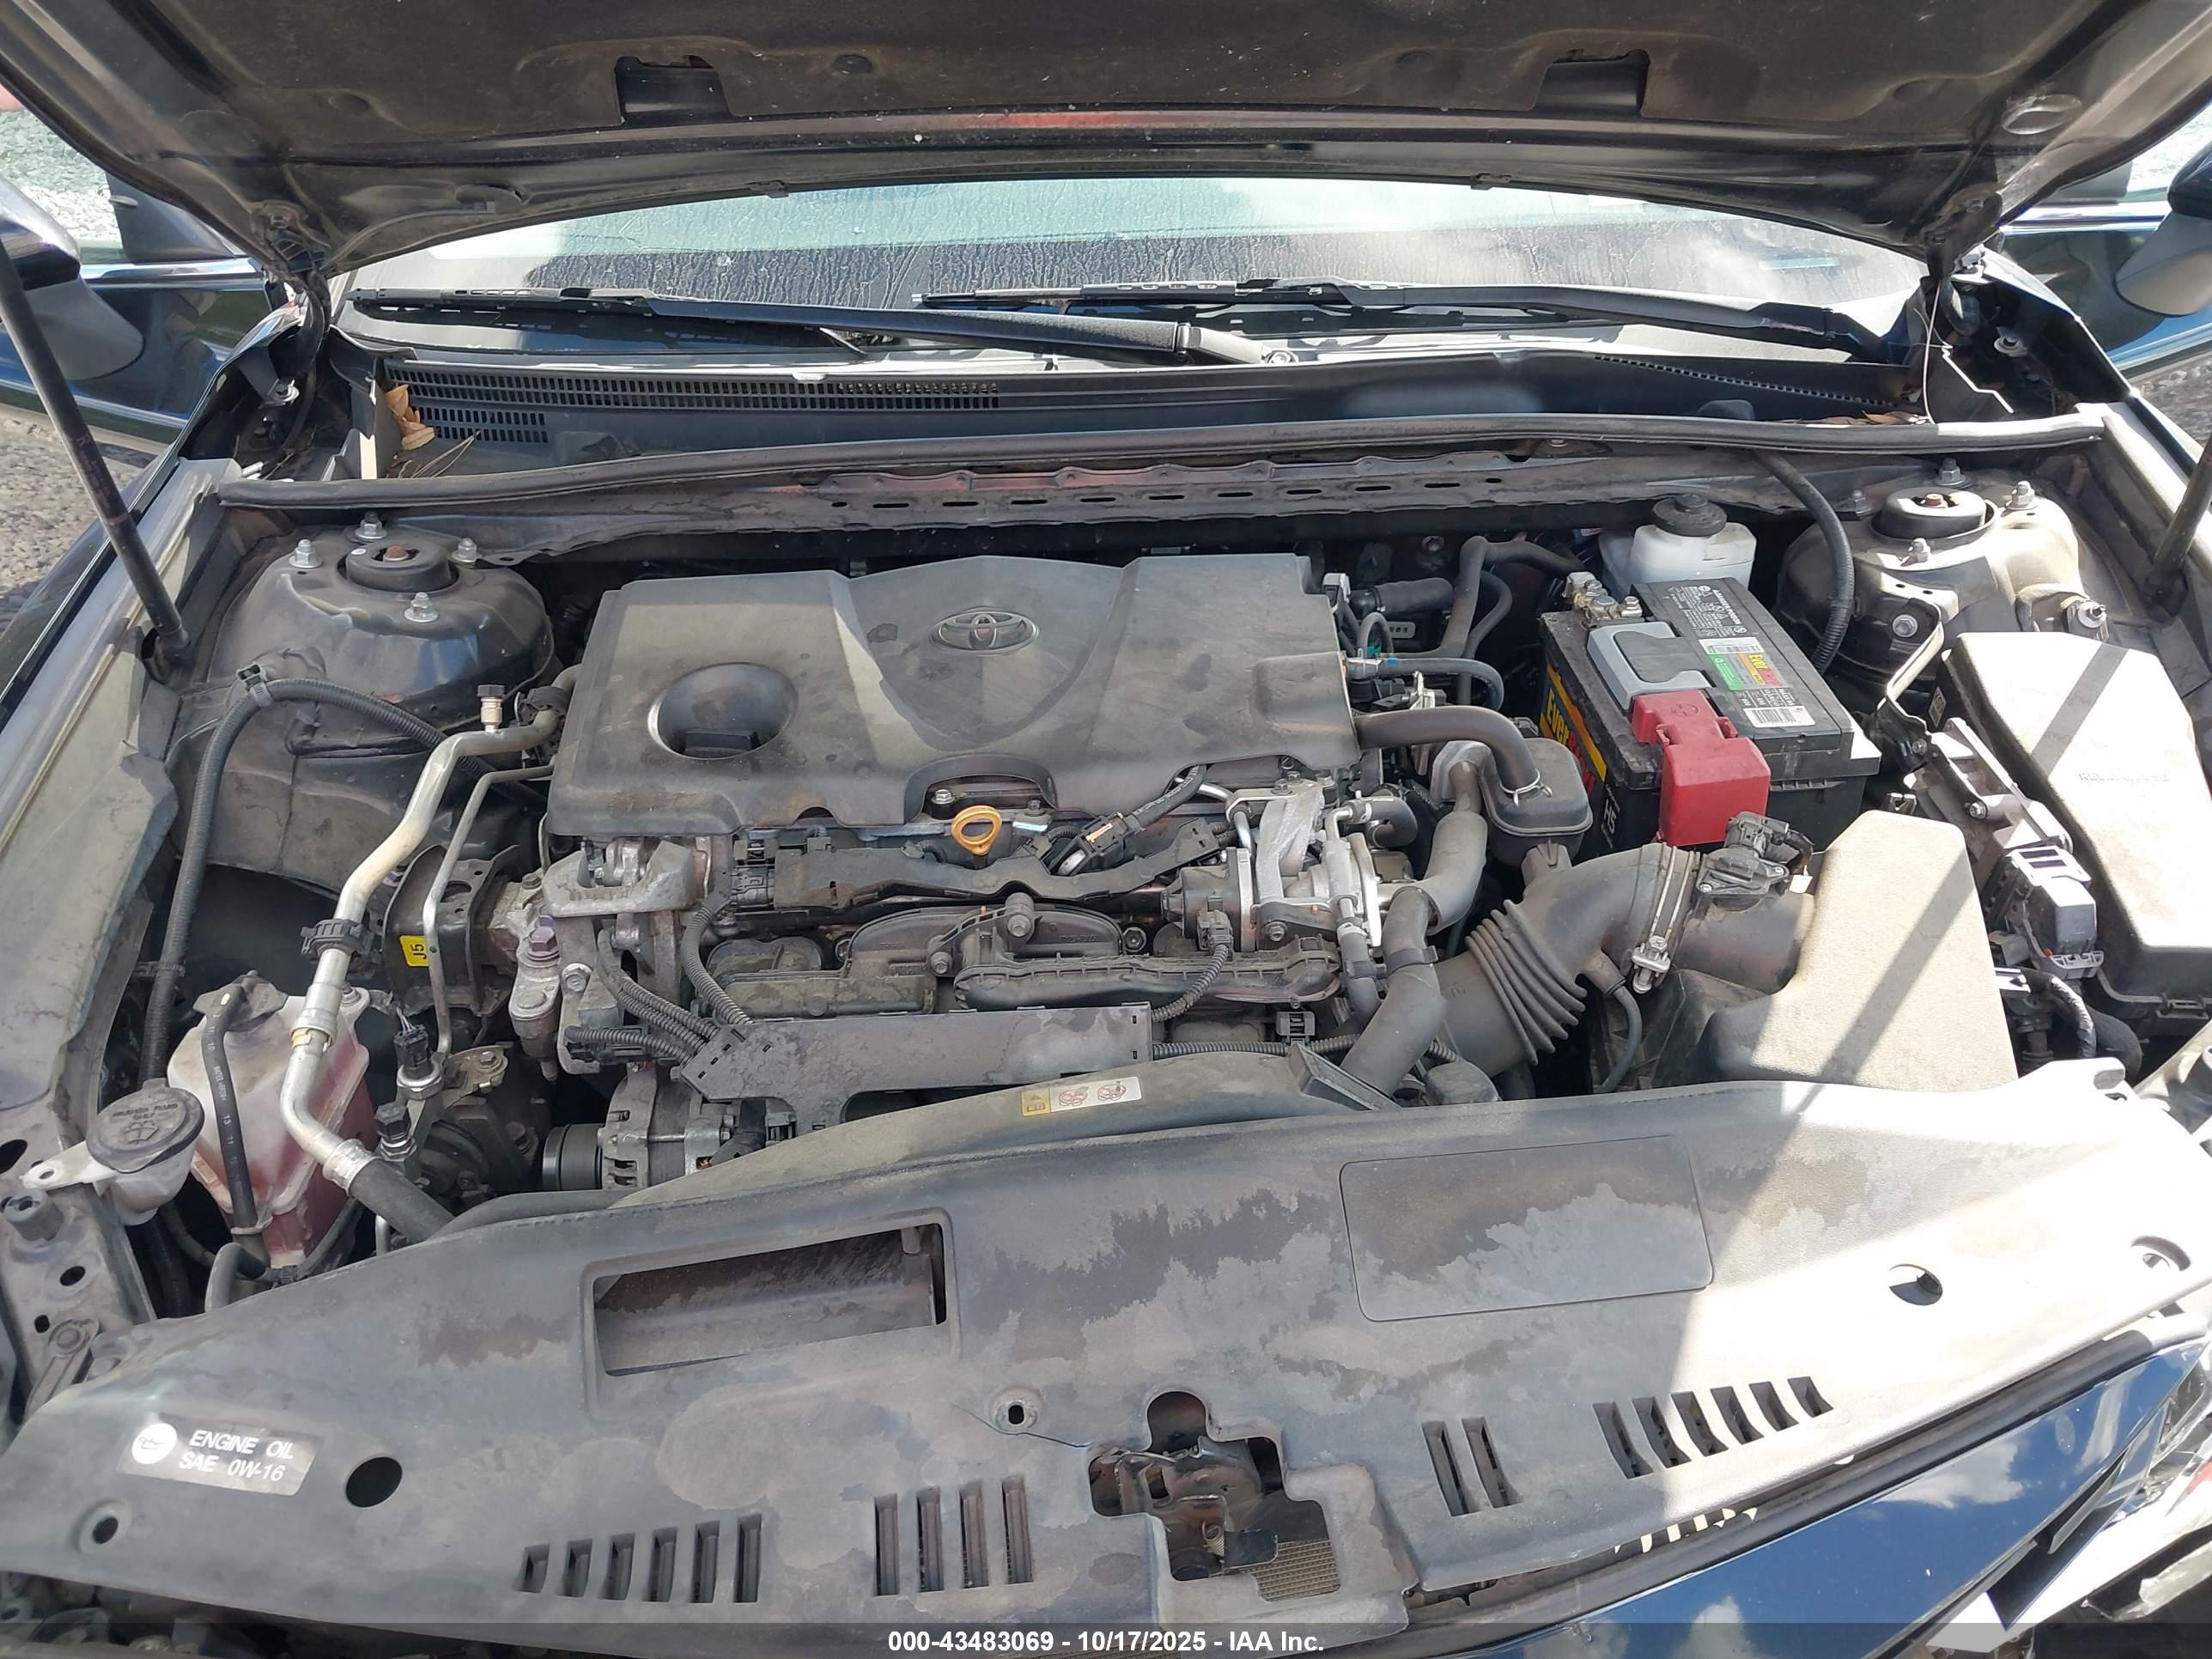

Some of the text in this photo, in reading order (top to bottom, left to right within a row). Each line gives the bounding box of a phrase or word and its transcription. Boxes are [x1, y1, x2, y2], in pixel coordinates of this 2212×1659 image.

[1603, 799, 1617, 834] H5
[411, 944, 428, 960] J5
[189, 1429, 295, 1460] ENGINE OIL
[178, 1452, 286, 1481] SAE 0W-16
